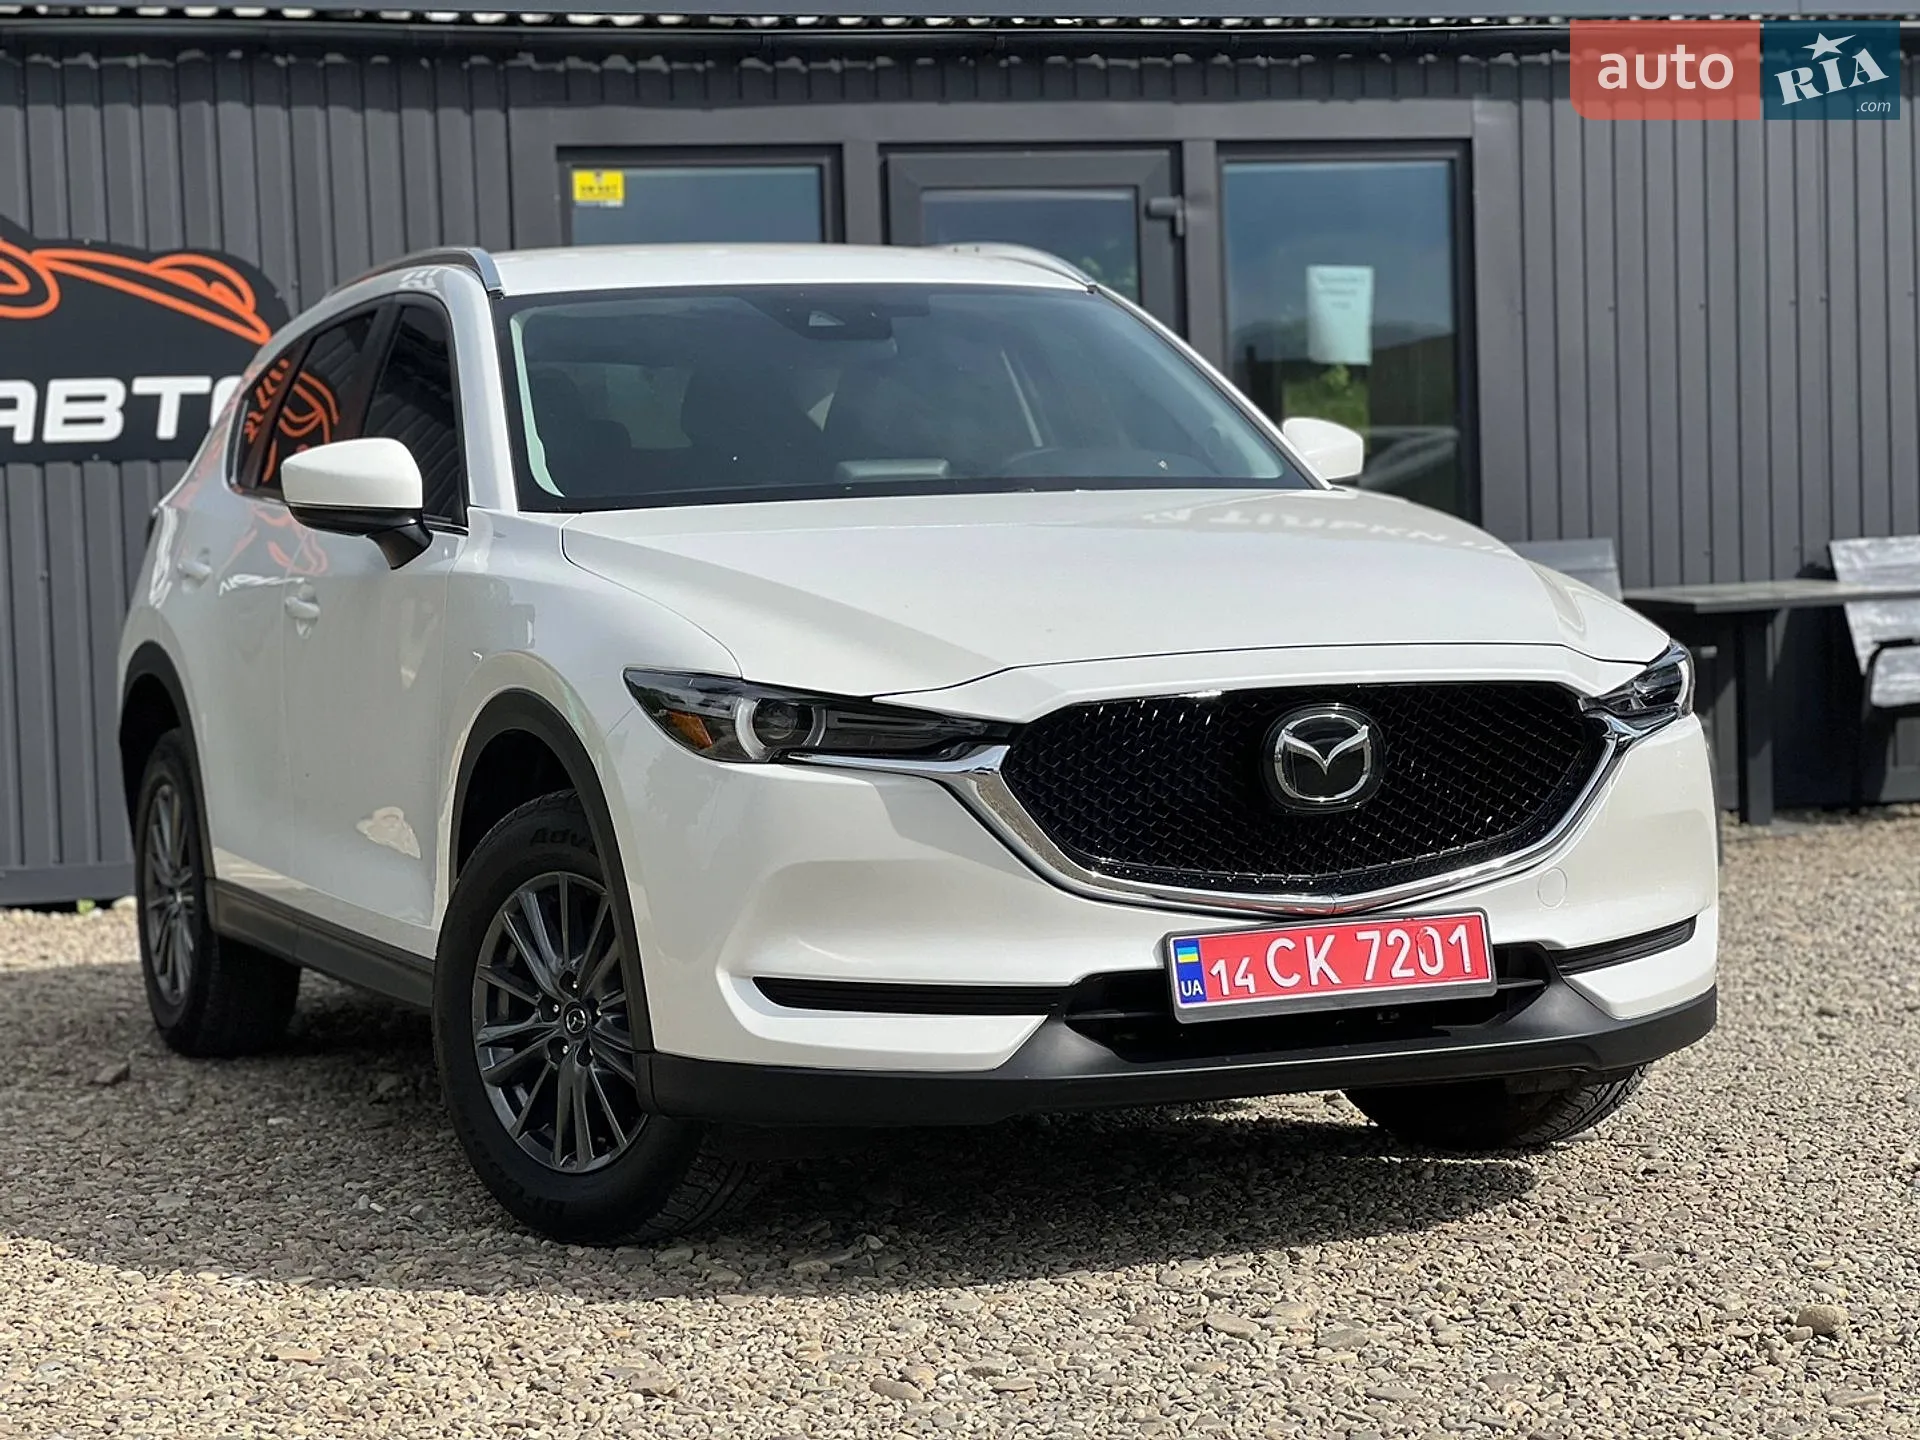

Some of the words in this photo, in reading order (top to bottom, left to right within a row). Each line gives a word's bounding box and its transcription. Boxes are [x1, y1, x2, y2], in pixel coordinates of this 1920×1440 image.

[0, 376, 242, 444] АВТ
[1180, 979, 1204, 997] UA
[1210, 956, 1256, 996] 14
[1265, 934, 1342, 989] CK
[1355, 924, 1473, 981] 7201
